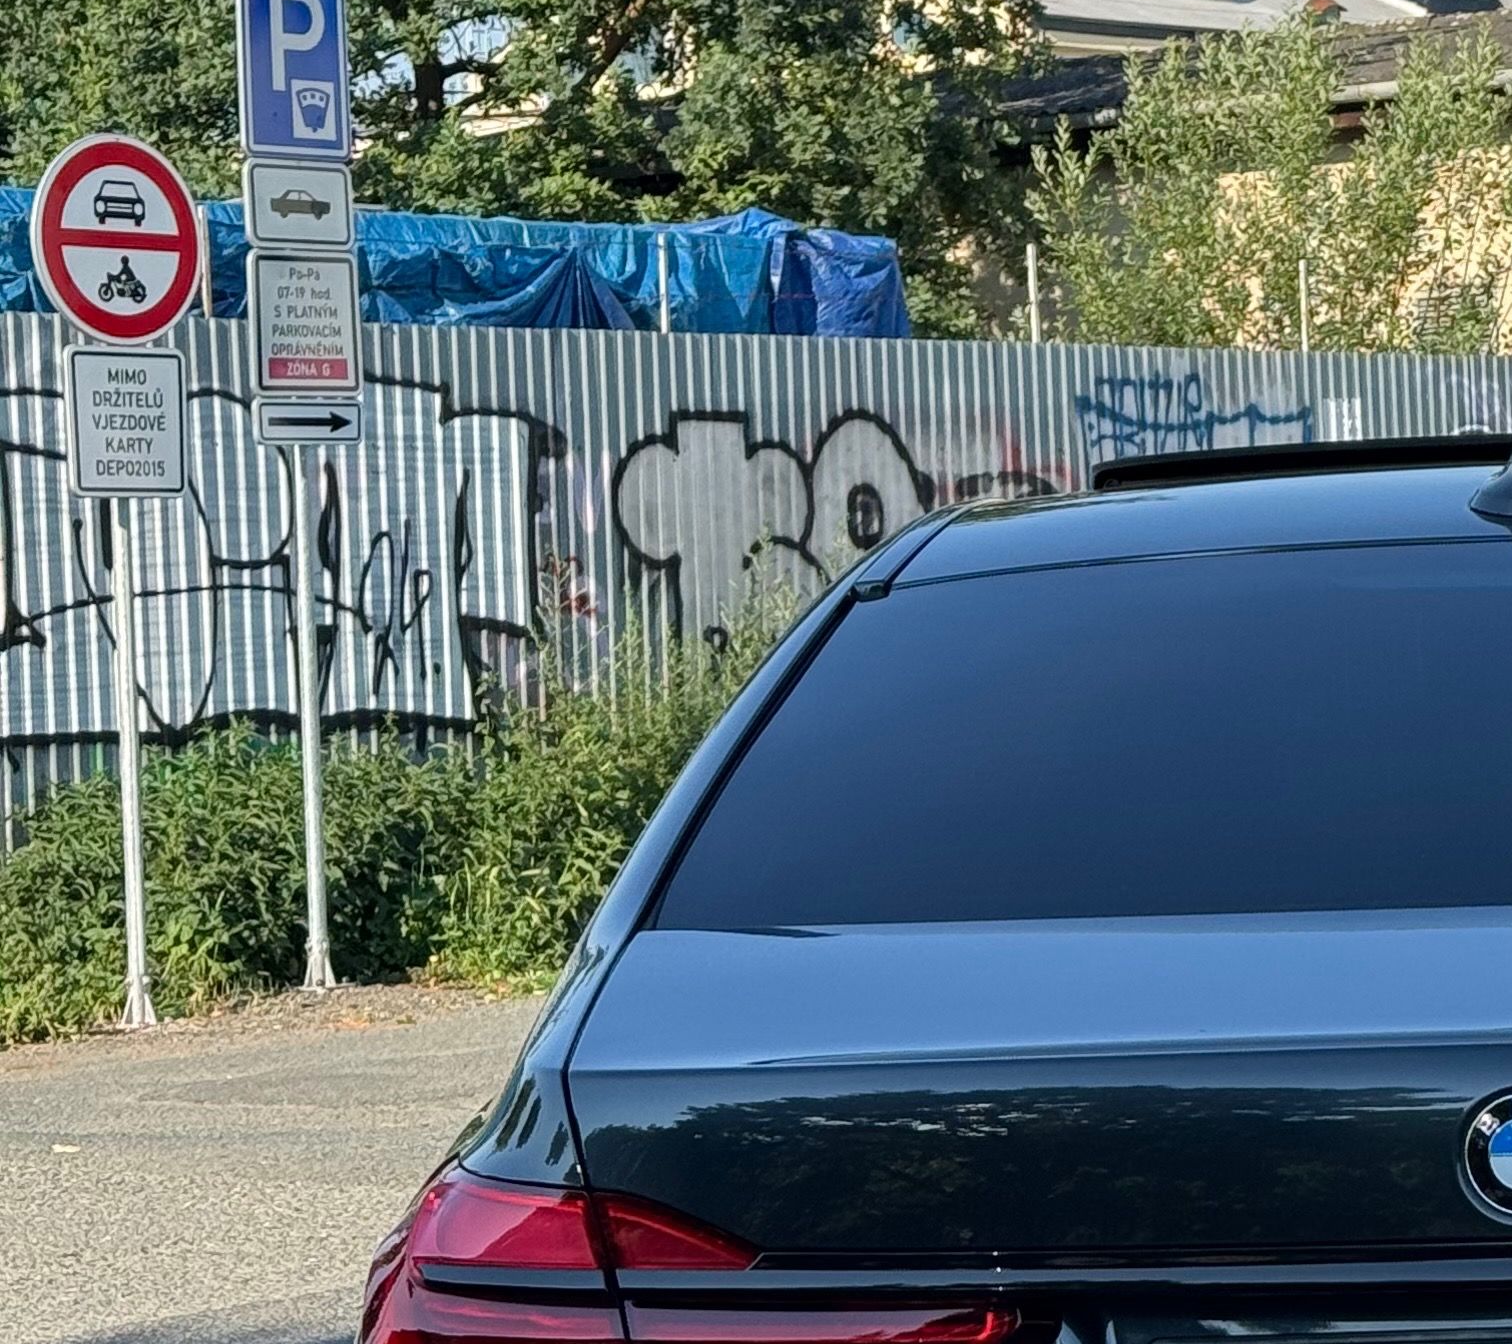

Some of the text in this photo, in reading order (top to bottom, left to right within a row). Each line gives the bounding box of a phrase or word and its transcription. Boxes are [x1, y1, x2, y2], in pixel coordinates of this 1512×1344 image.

[277, 286, 306, 299] 07-19
[274, 303, 338, 320] S PLATNÝM
[272, 322, 342, 338] PARKOVACÍM
[107, 367, 147, 385] MIMO
[287, 359, 331, 377] ZÓNA G
[92, 387, 164, 408] DRŽITELŮ
[92, 411, 166, 431] VJEZDOVÉ
[105, 437, 153, 454] KARTY
[96, 459, 165, 477] DEPO2015
